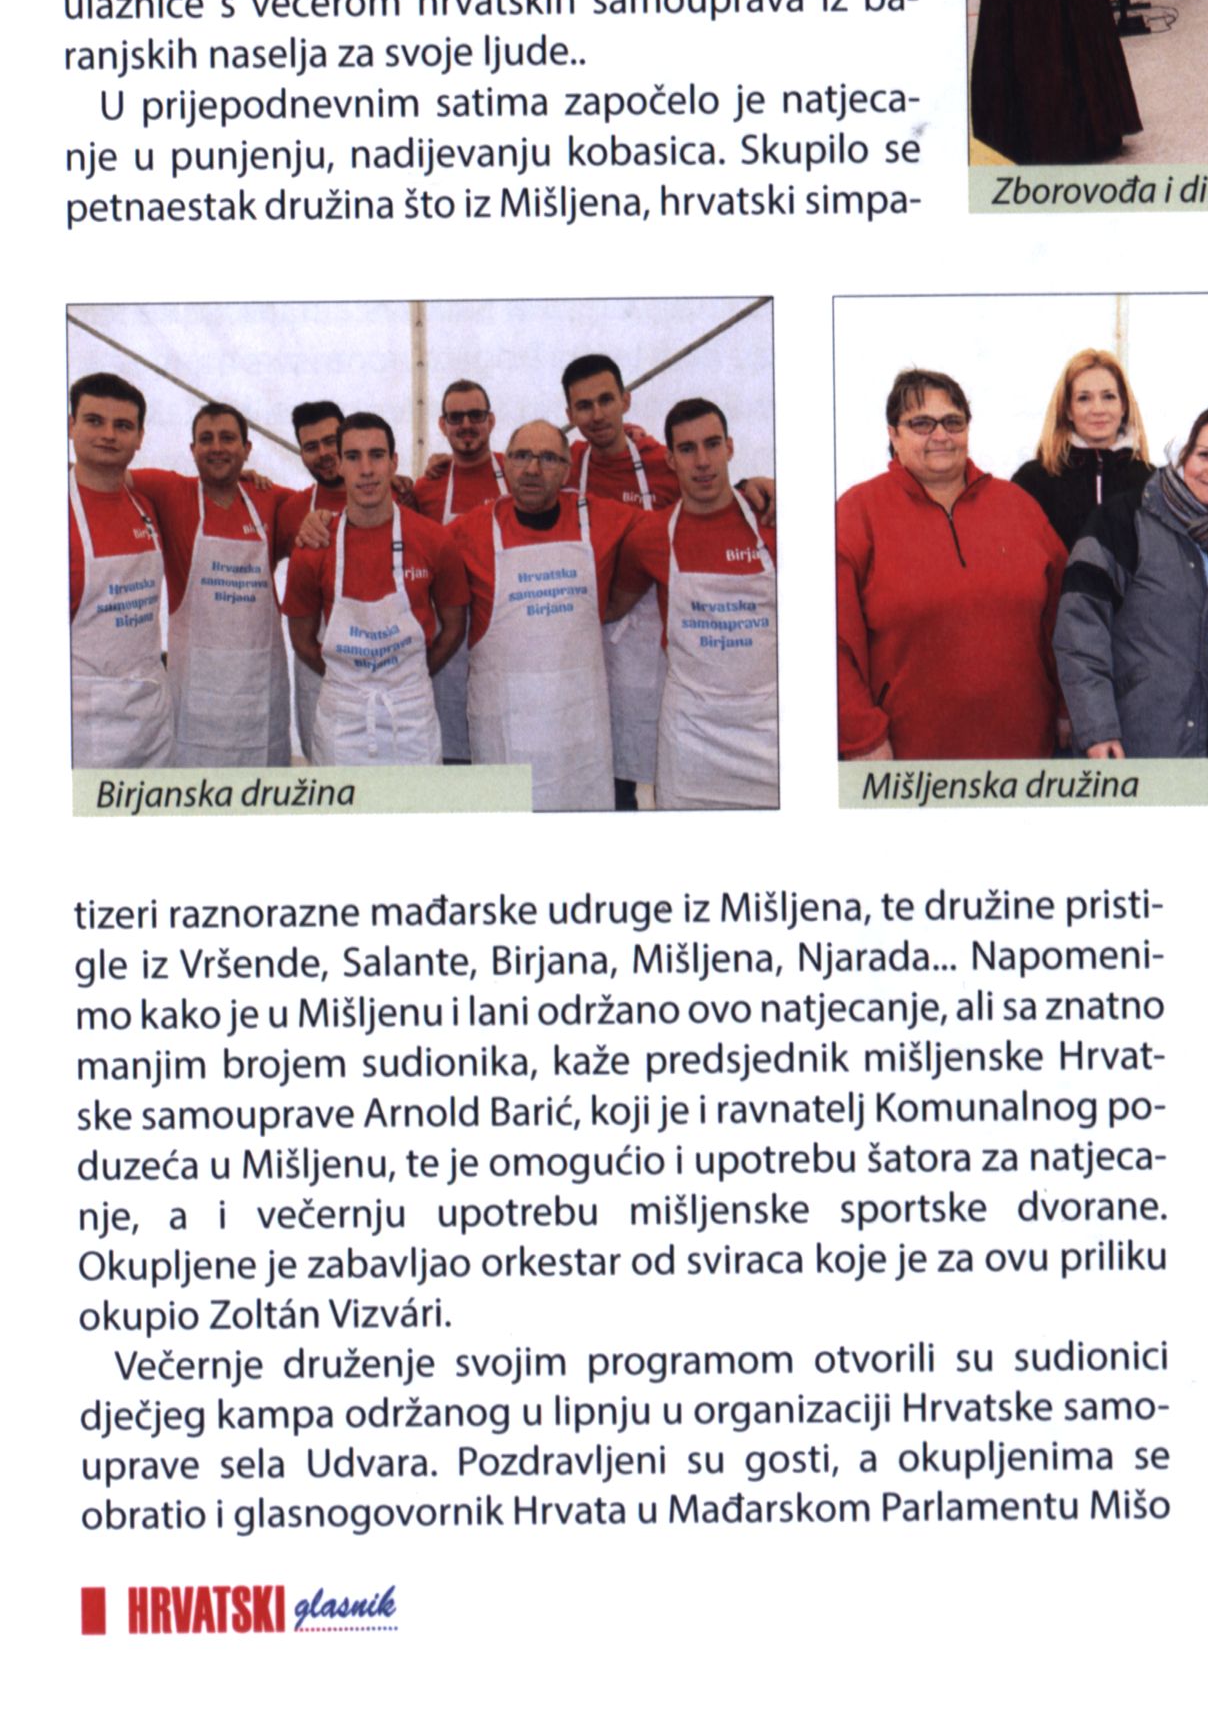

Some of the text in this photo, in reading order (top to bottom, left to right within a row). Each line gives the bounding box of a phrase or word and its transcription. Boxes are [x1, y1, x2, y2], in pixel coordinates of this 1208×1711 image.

[65, 33, 586, 78] ranjskih naselja za svoje ljude..
[991, 175, 1156, 205] Zborovođa
[1164, 176, 1173, 203] i
[518, 567, 578, 584] Hrvatska
[508, 584, 589, 602] samouprava
[527, 602, 575, 618] Birjana
[690, 599, 758, 614] Hrvatska
[681, 616, 770, 633] samouprava
[699, 635, 754, 652] Birjana
[97, 778, 355, 816] Birjanska družina
[862, 769, 1139, 807] Mišljenska družina
[73, 888, 1163, 932] tizeri raznorazne mađarske udruge iz Mišljena, te družine pristi-
[75, 939, 1164, 988] gle iz Vršende, Salante, Birjana, Mišljena, Njarada... Napomeni-
[79, 1297, 451, 1339] okupio Zoltán Vizvári.
[128, 1585, 397, 1635] HRVATSKI glasnik
